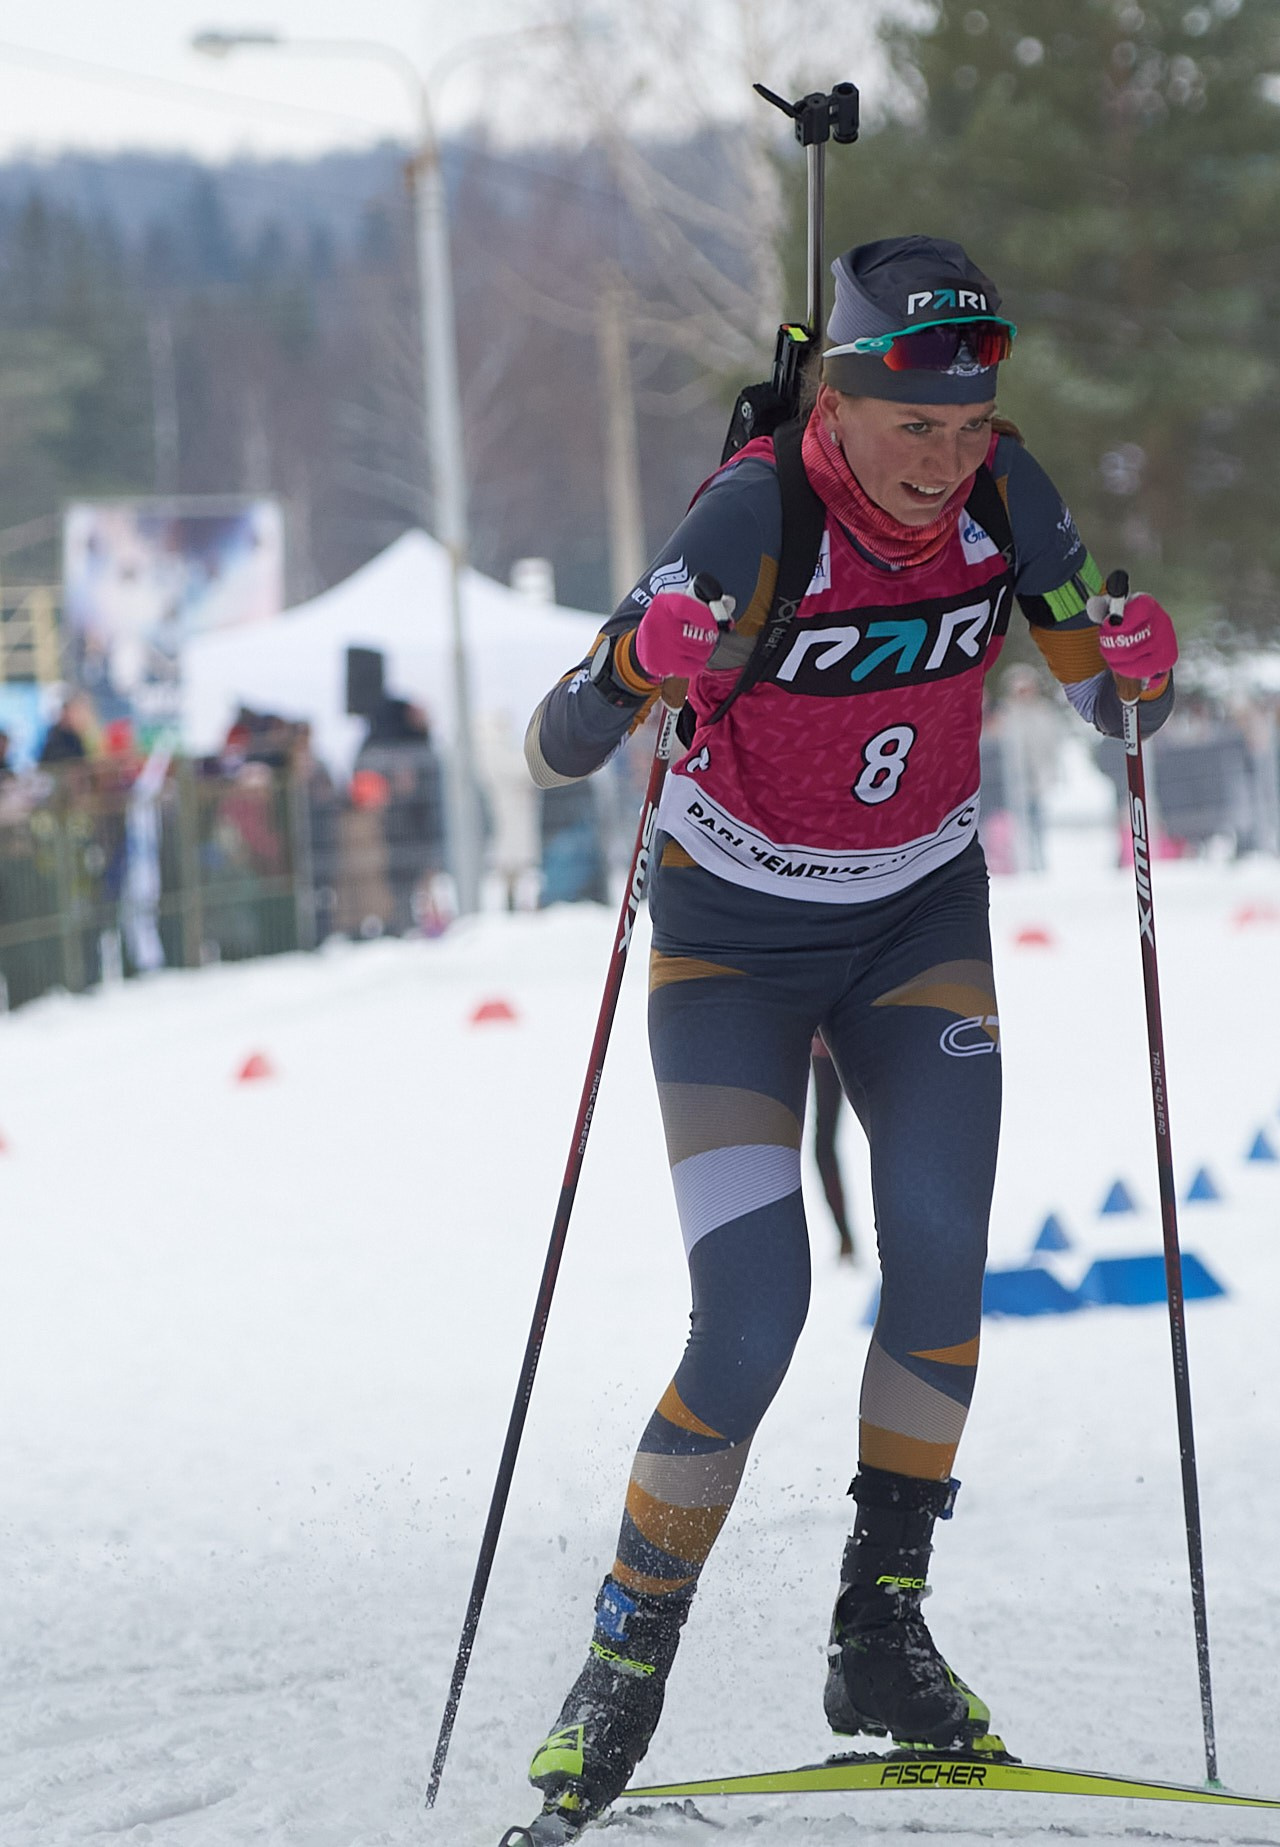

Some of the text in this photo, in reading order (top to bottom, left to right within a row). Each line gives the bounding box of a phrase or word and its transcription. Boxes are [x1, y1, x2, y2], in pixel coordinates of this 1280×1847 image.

[907, 288, 987, 315] PARI
[851, 722, 917, 807] 8
[880, 1764, 987, 1786] FISCHER
